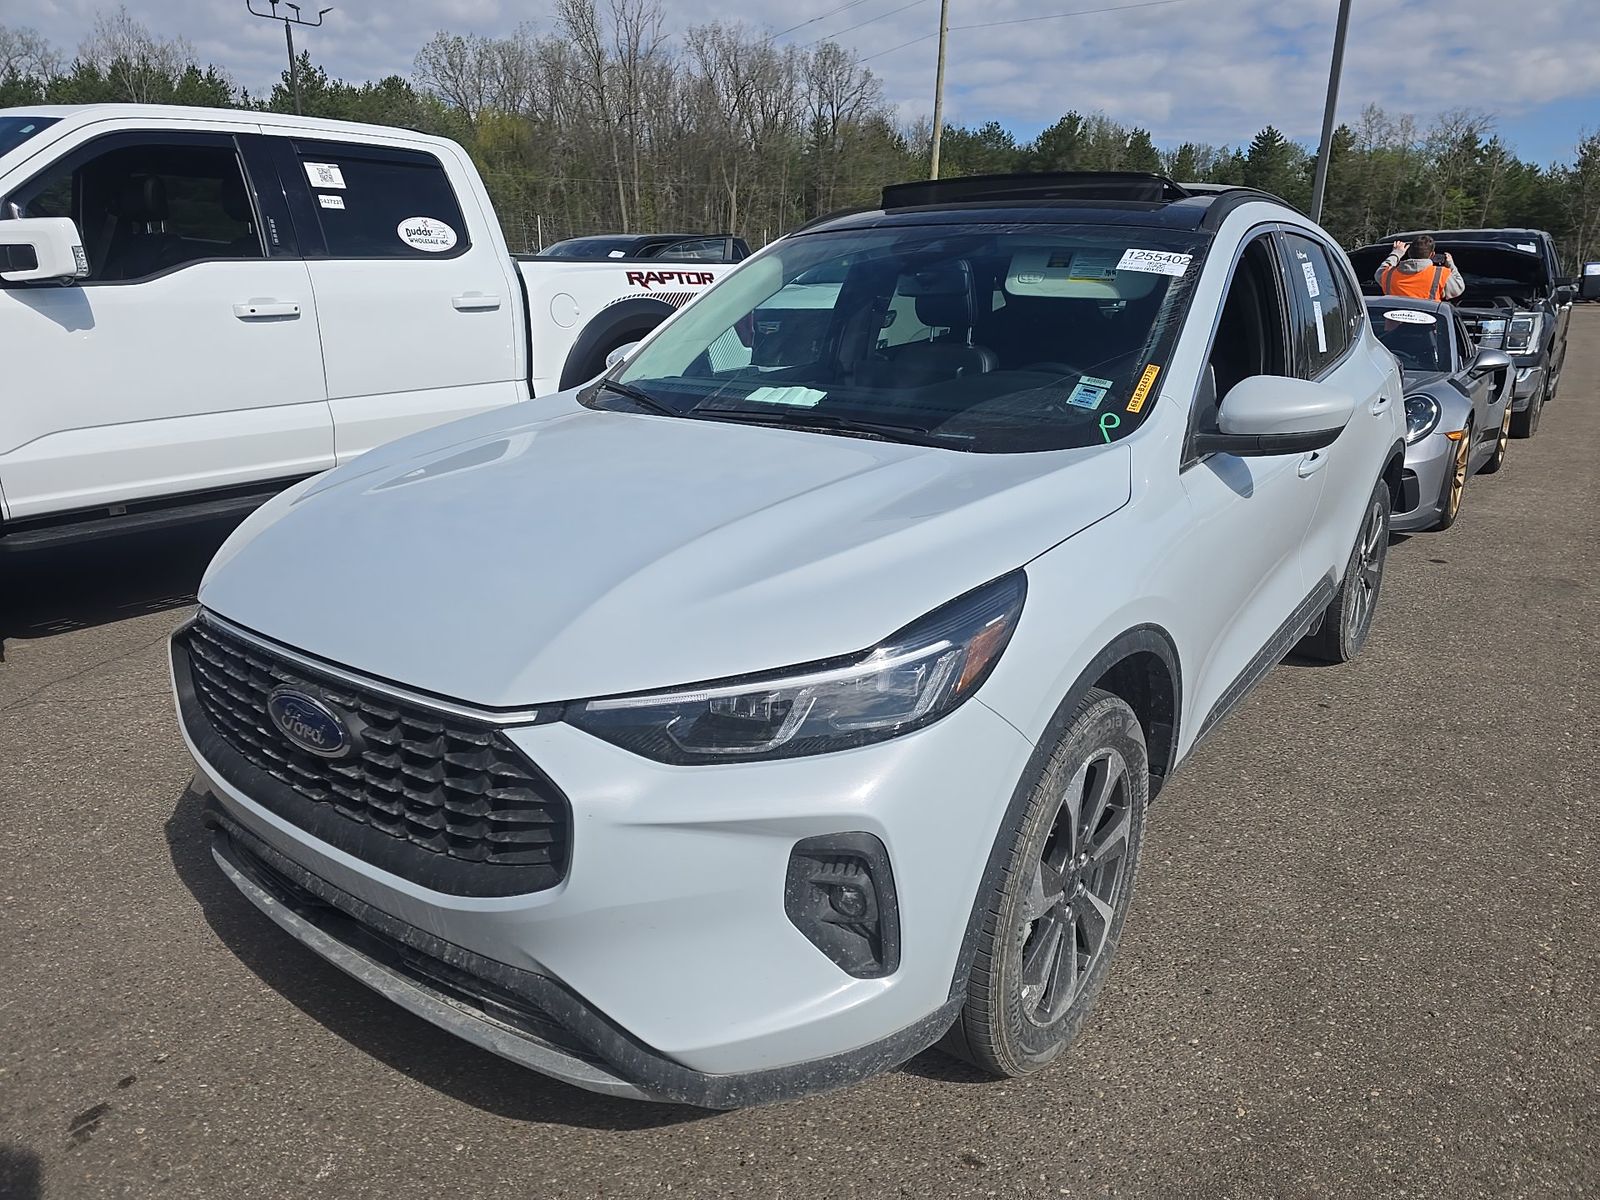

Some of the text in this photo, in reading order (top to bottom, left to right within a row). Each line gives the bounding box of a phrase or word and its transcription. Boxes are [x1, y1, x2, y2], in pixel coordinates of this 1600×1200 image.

[1128, 251, 1192, 266] 1255402
[625, 271, 715, 291] RAPTOR
[281, 702, 326, 745] Ford
